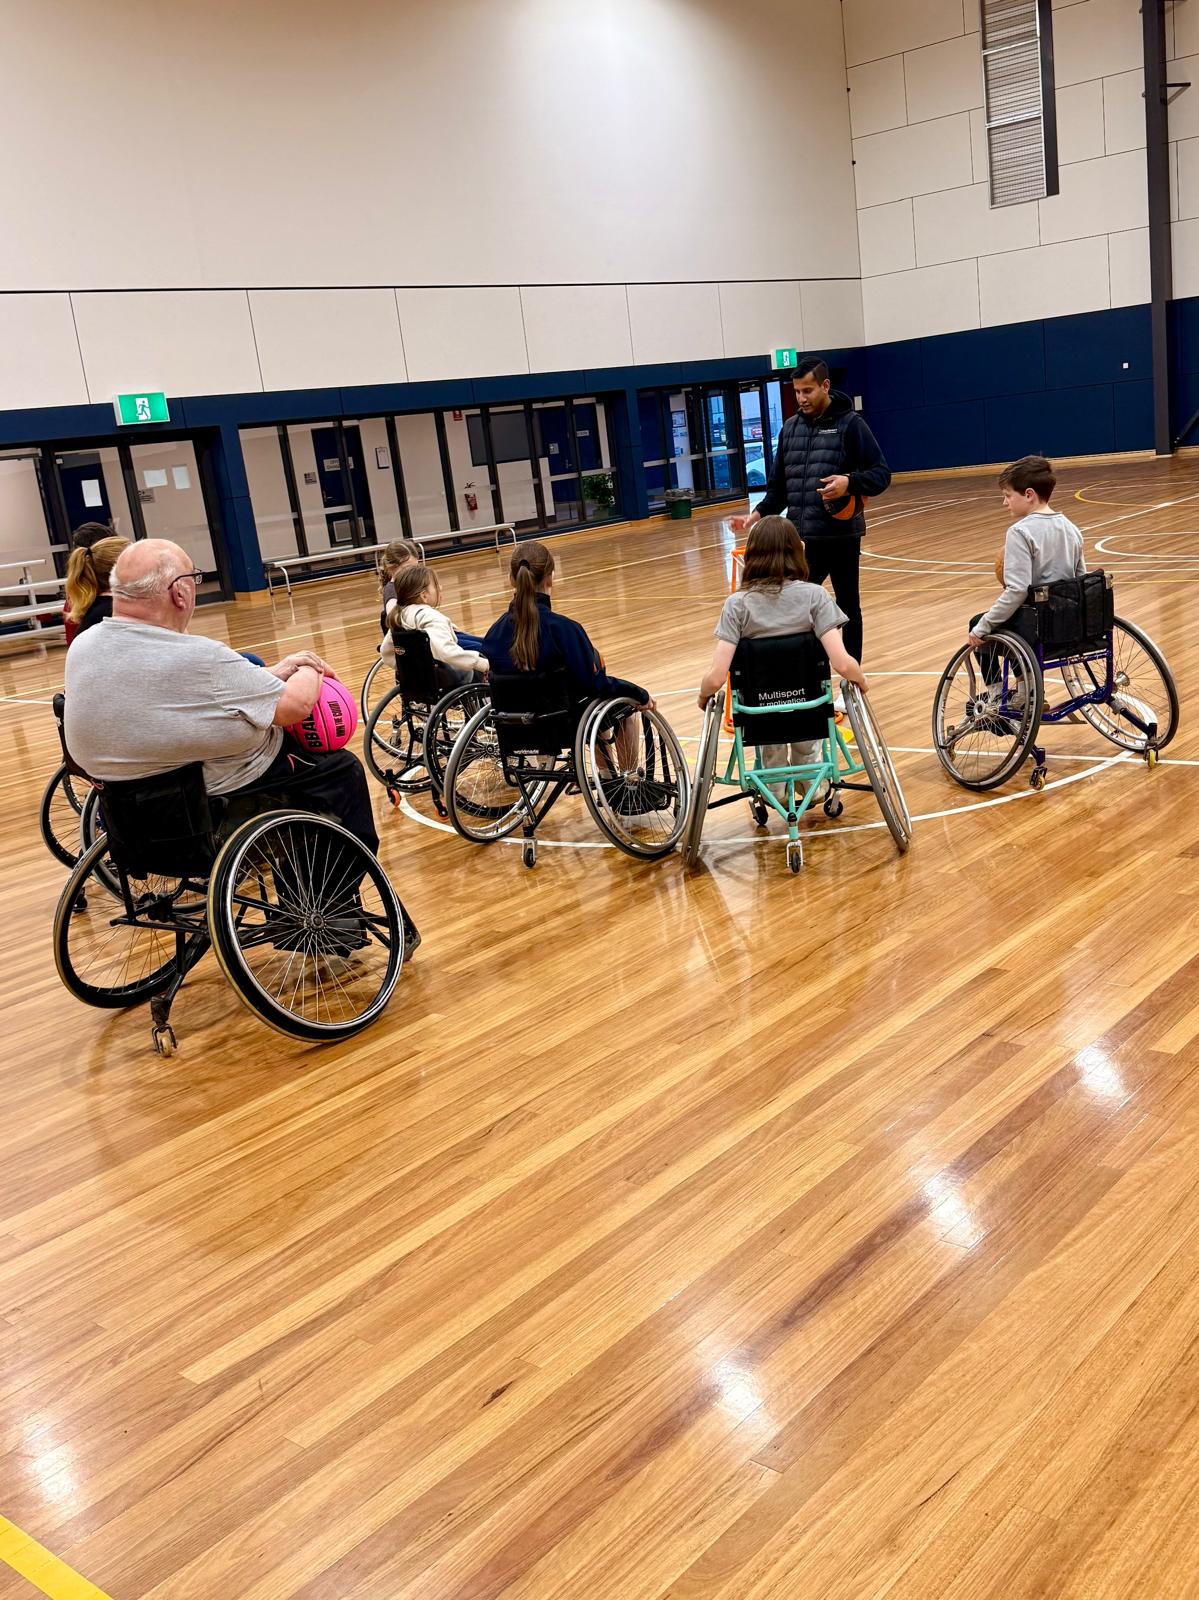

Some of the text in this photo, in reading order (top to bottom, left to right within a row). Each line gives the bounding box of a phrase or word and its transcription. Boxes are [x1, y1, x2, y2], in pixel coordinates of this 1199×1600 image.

[758, 688, 805, 700] Multisport
[327, 701, 343, 717] COURT
[334, 717, 343, 725] THE
